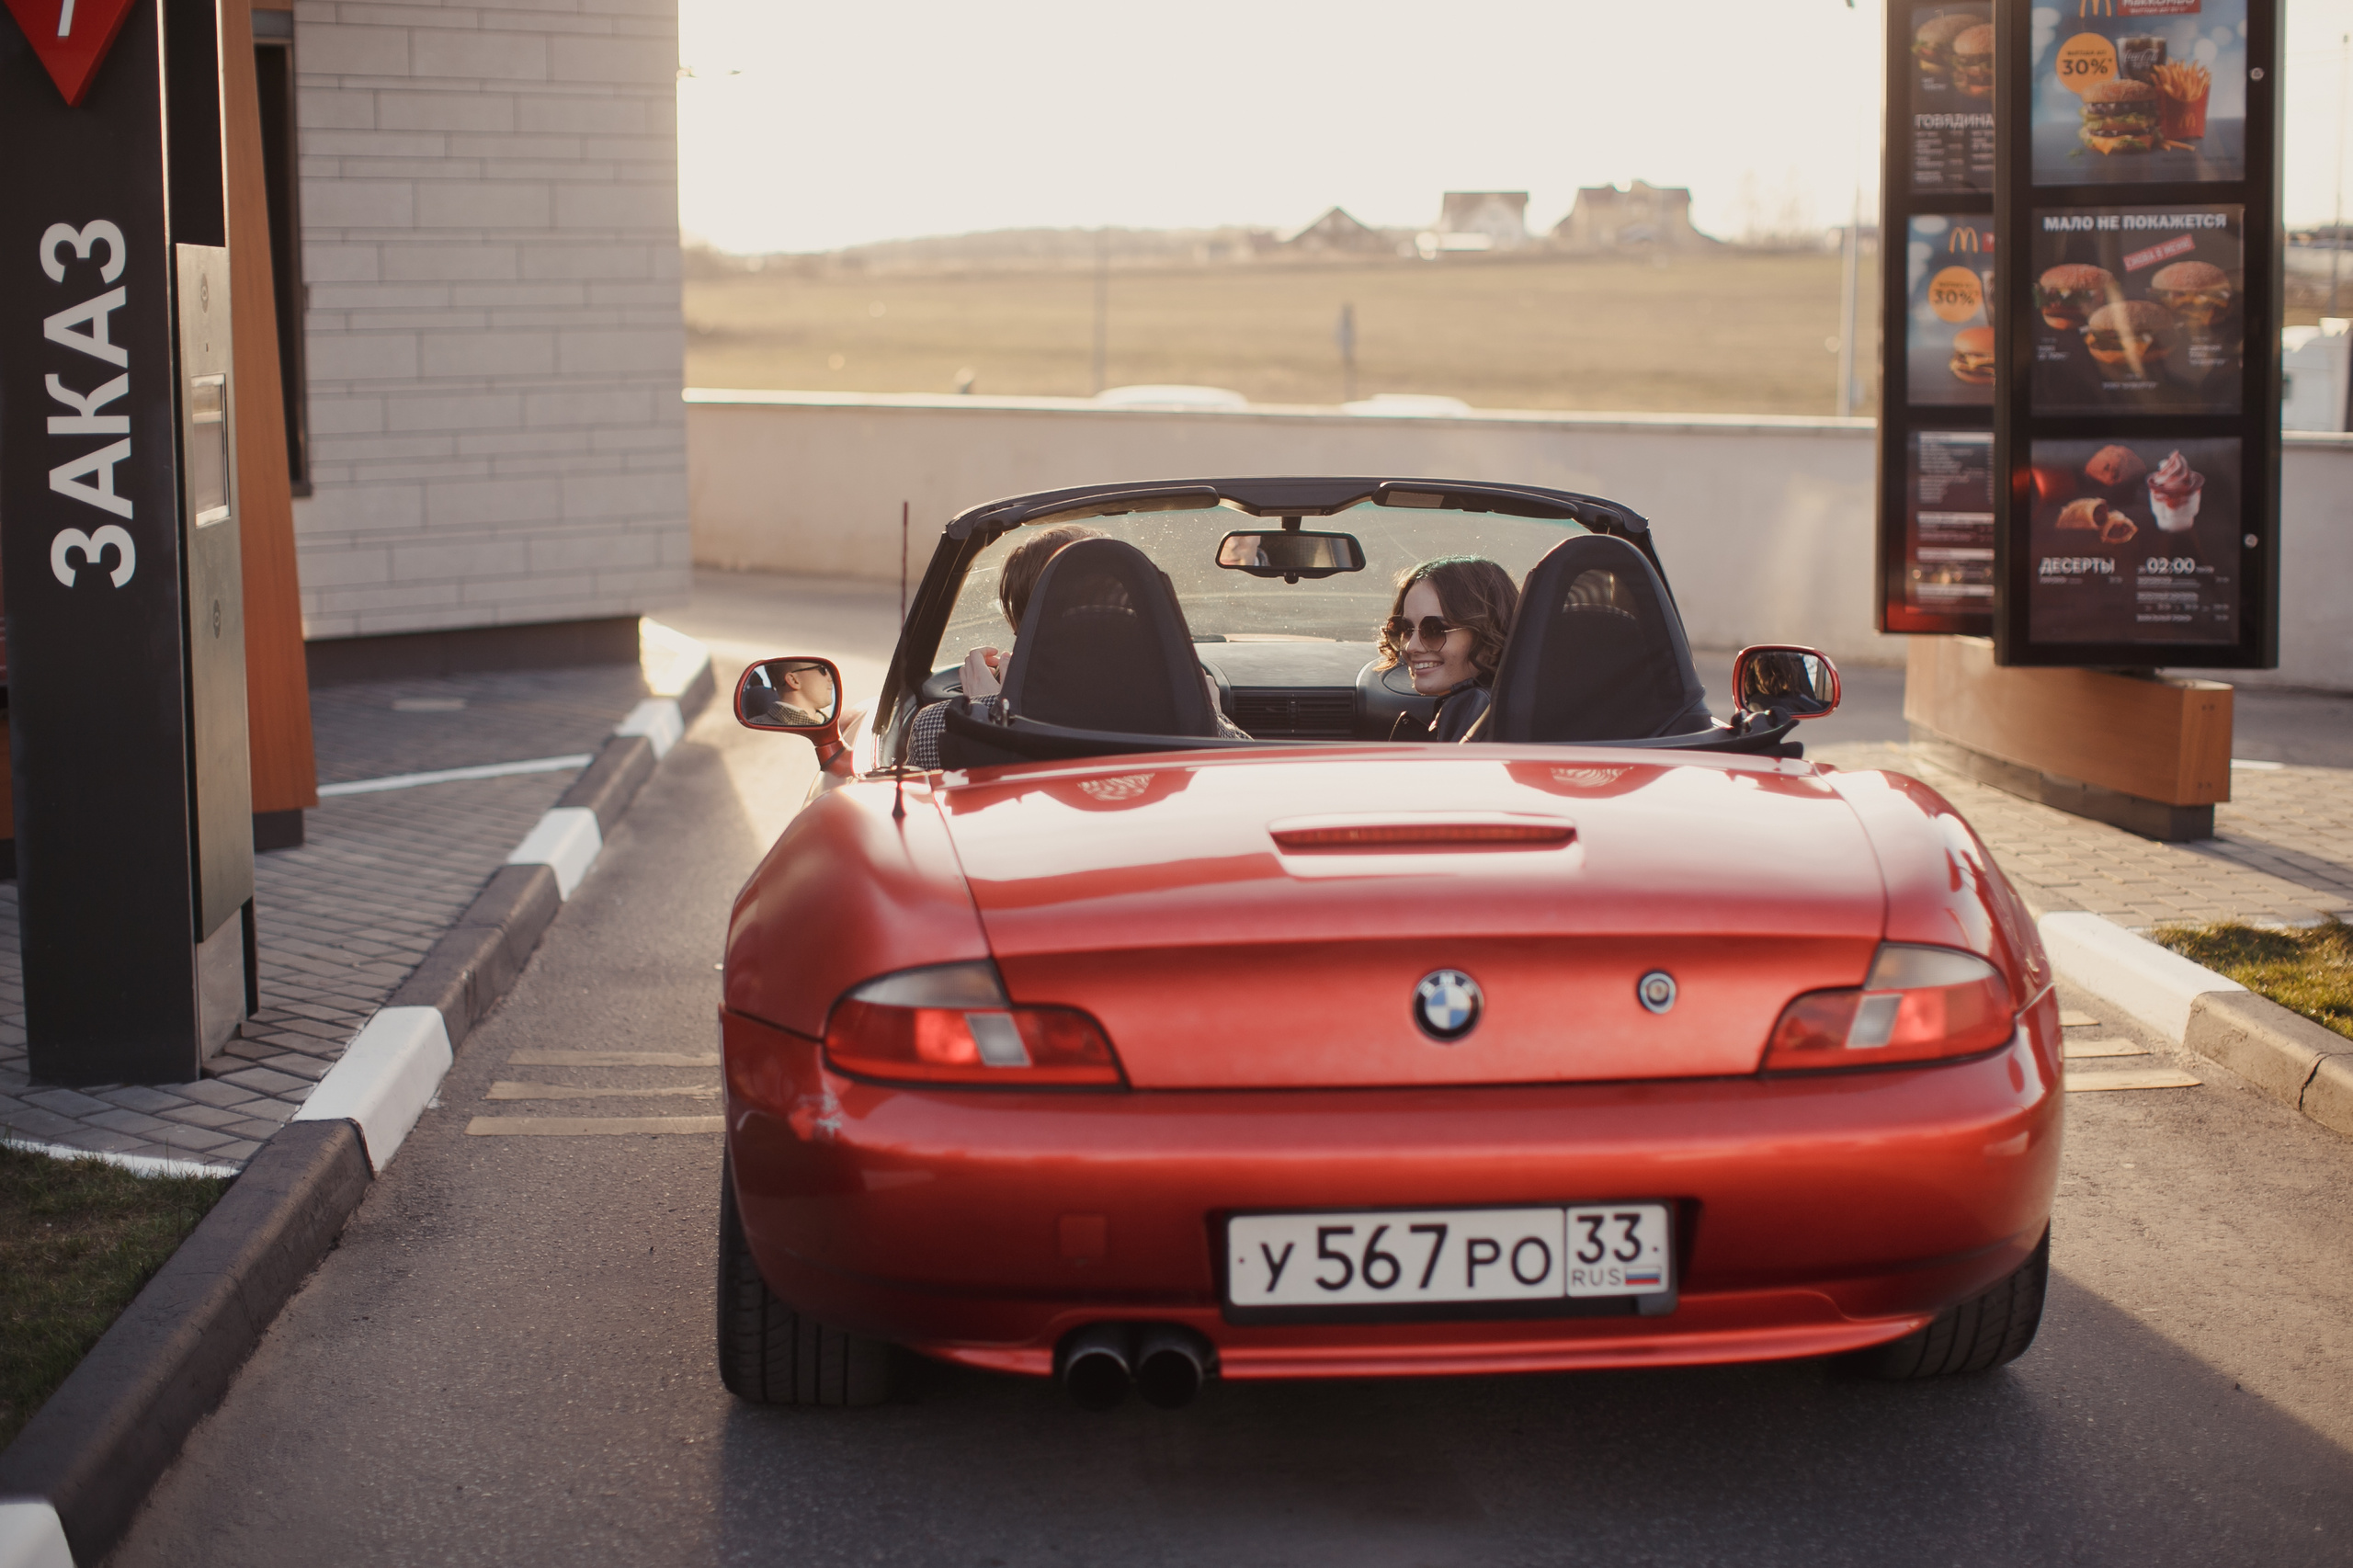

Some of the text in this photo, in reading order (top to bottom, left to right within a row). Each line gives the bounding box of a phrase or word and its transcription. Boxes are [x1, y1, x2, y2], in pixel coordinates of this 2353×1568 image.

[1914, 113, 1994, 130] ГОВЯДИНА
[2043, 213, 2227, 231] МАЛО НЕ ПОКАЖЕТСЯ
[40, 219, 136, 588] ЗАКАЗ
[2039, 557, 2115, 574] ДЕСЕРТЫ
[2146, 556, 2196, 574] 02:00
[1576, 1213, 1642, 1265] 33
[1572, 1267, 1621, 1287] RUS
